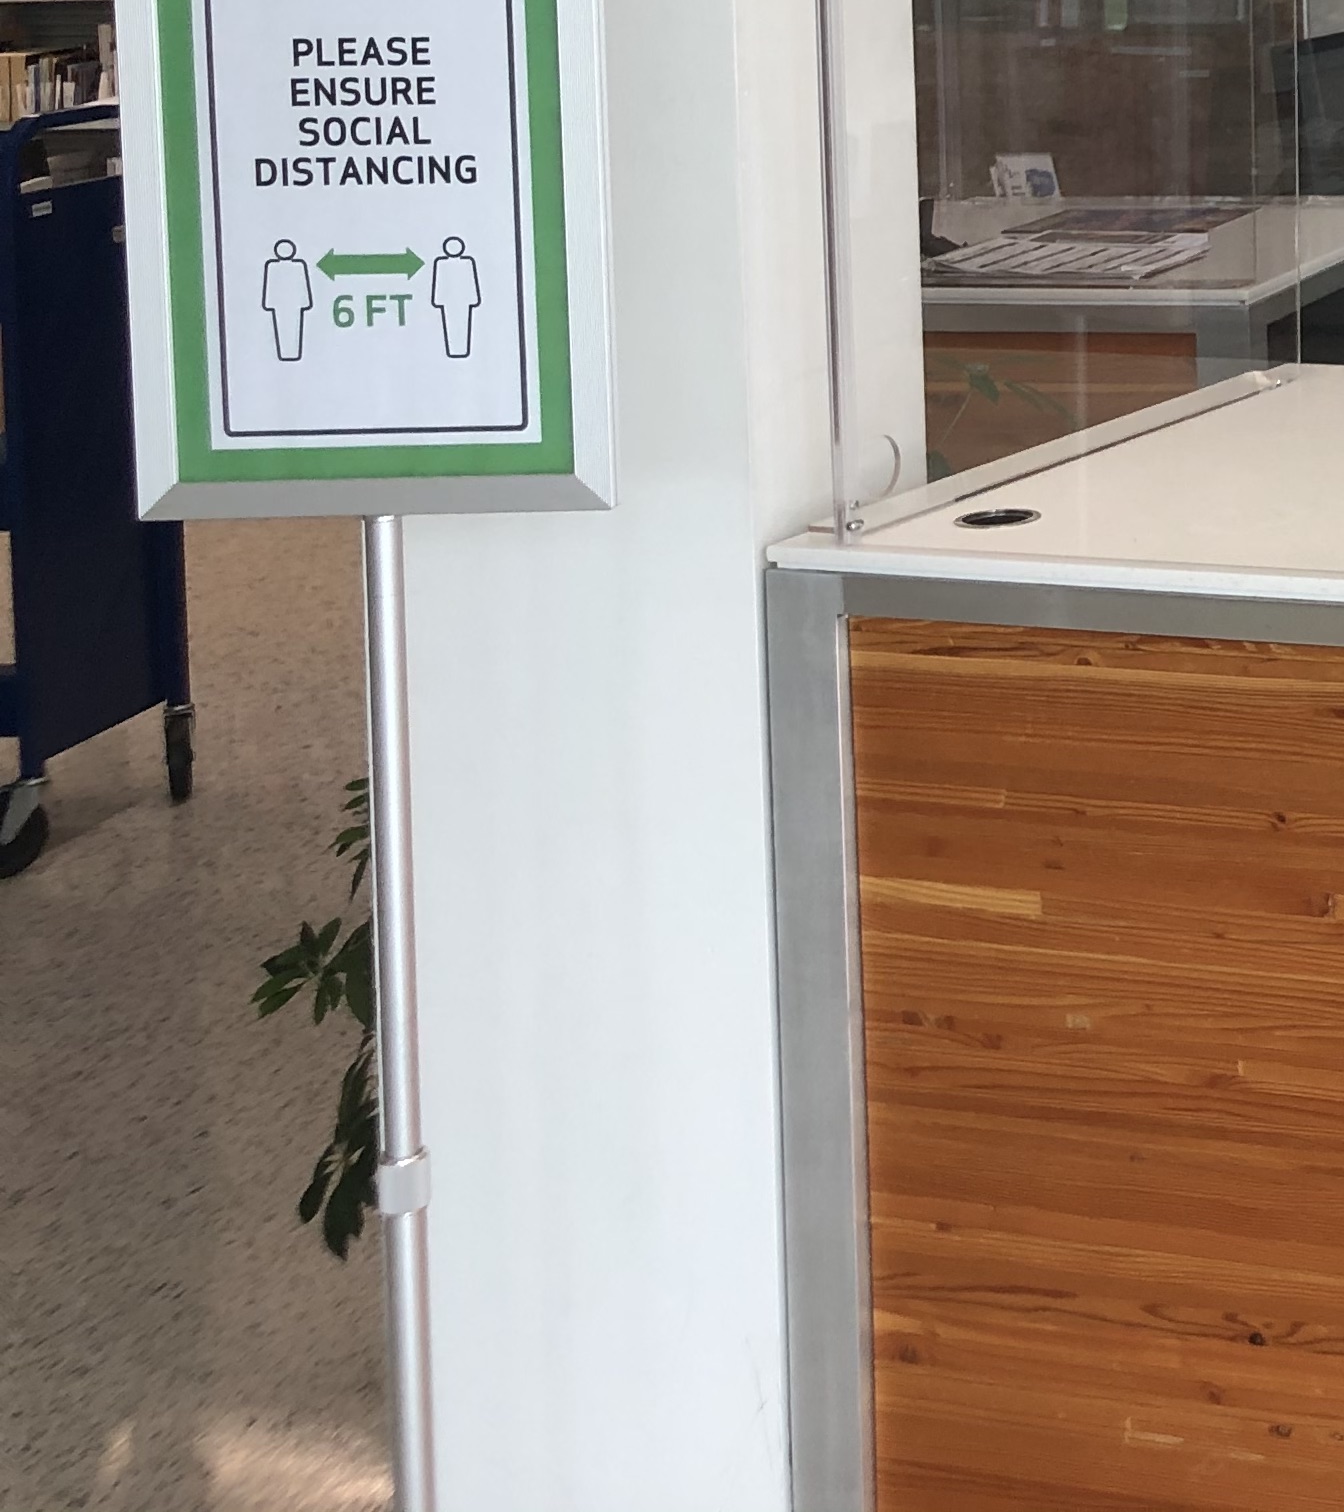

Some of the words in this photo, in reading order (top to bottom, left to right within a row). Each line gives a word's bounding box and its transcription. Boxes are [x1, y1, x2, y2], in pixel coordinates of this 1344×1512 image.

[292, 37, 432, 66] PLEASE
[290, 77, 436, 106] ENSURE
[297, 116, 432, 146] SOCIAL
[255, 155, 478, 187] DISTANCING
[332, 295, 355, 327] 6
[366, 294, 414, 326] FT
